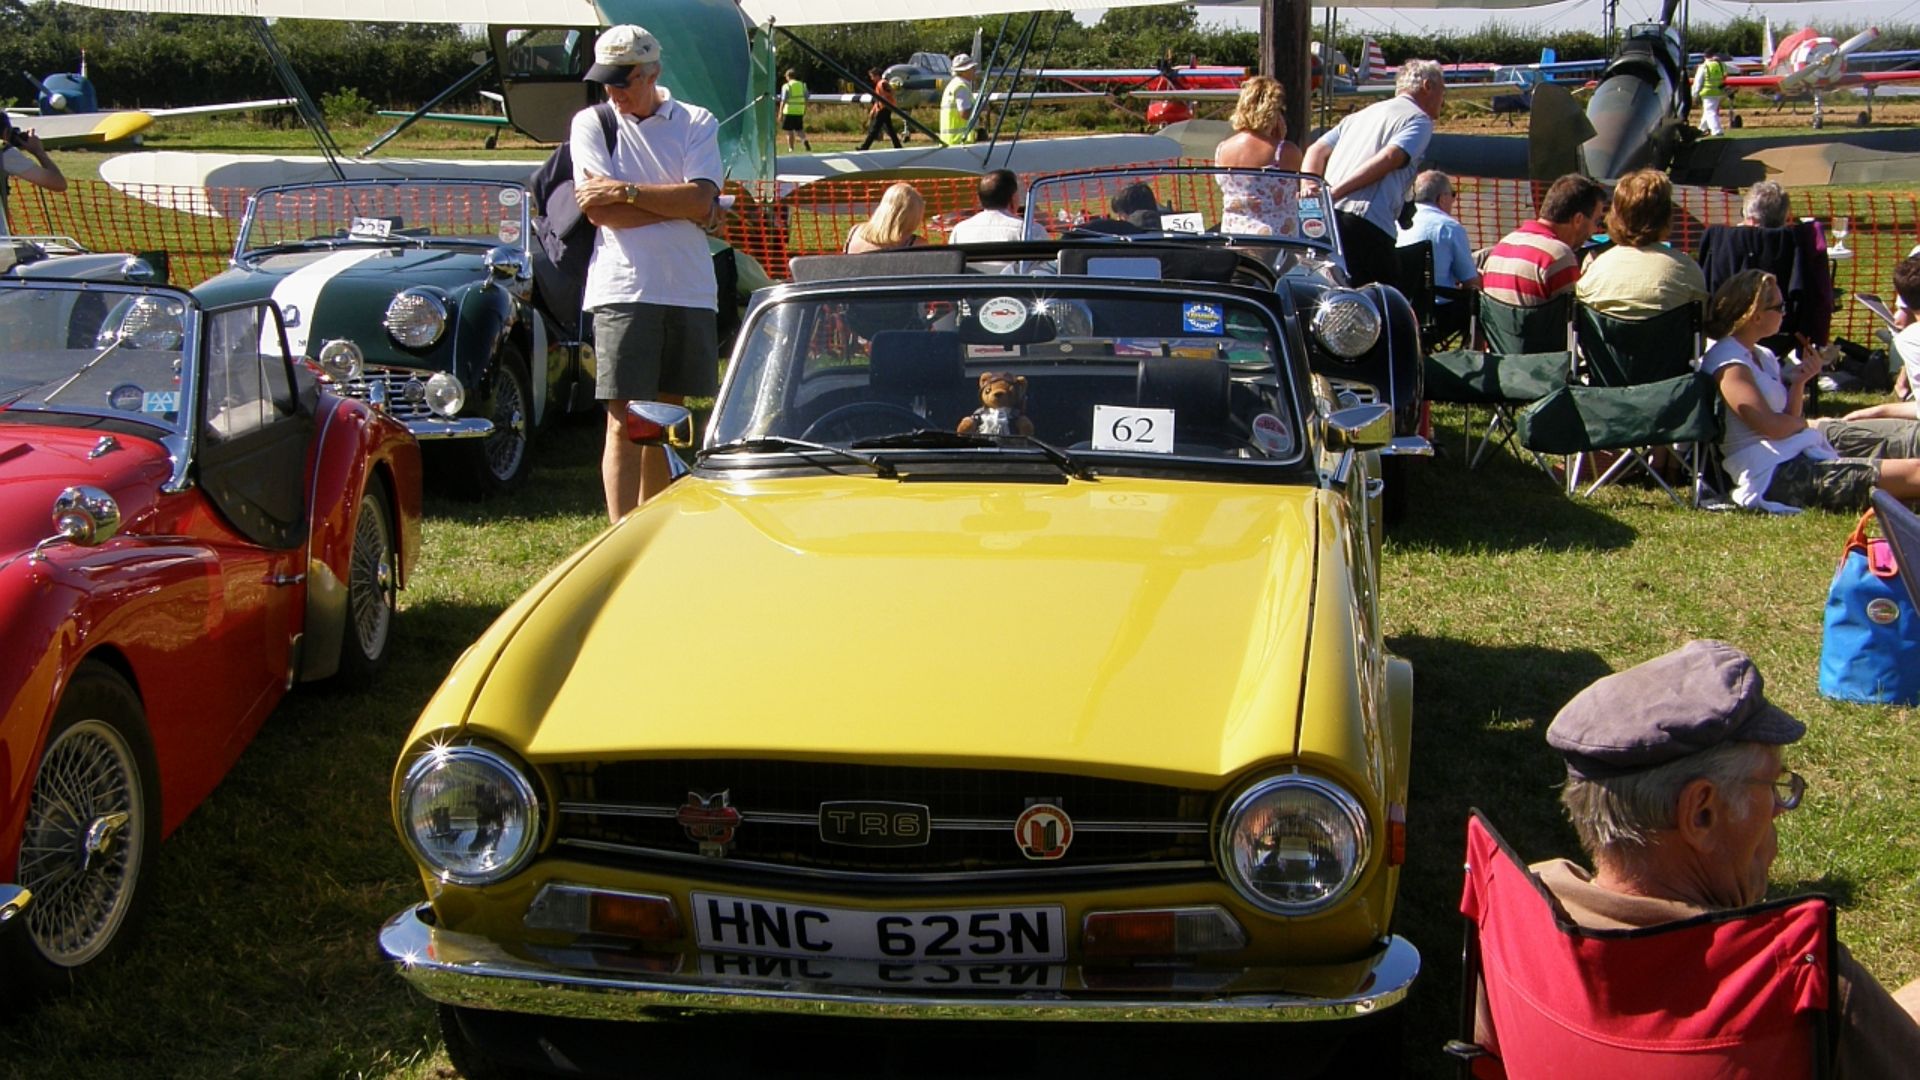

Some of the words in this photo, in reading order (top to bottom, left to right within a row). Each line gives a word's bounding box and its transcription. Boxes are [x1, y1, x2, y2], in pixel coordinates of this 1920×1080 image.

[1112, 415, 1156, 443] 62
[827, 811, 920, 837] TR6
[707, 899, 833, 952] HNC
[876, 911, 1050, 957] 625N
